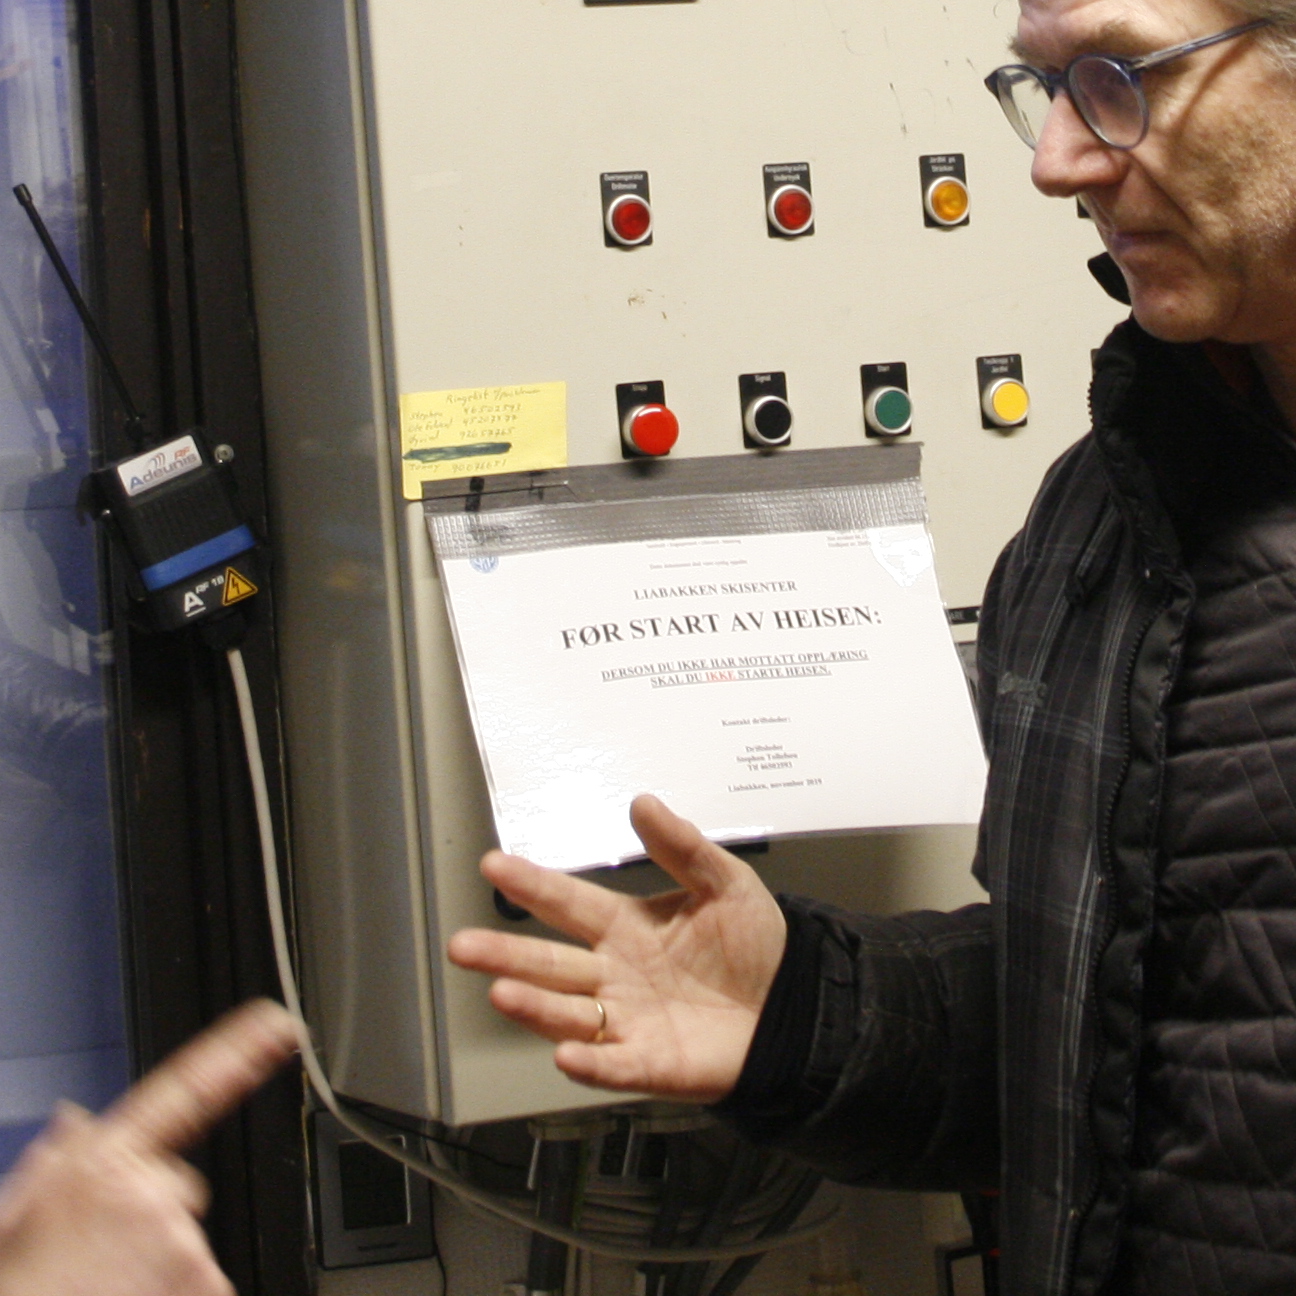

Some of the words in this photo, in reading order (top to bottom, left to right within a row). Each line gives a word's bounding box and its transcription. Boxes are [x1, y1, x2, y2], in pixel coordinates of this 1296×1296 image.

[173, 445, 193, 460] RF
[130, 454, 197, 490] Adeunis
[633, 584, 718, 600] LIABAKKEN
[720, 581, 798, 595] SKISENTER
[560, 622, 624, 650] FØR
[630, 613, 721, 639] START
[730, 611, 765, 632] AV
[772, 605, 882, 630] HEISEN:
[601, 663, 655, 680] DERSOM
[657, 660, 675, 673] DU
[677, 658, 708, 671] IKKE
[710, 656, 737, 669] HAR
[738, 653, 796, 667] MOTTATT
[798, 649, 869, 663] OPPLÆRING
[650, 675, 684, 688] SKAL
[686, 673, 704, 685] DU
[705, 670, 737, 682] IKKE
[737, 667, 784, 680] STARTE
[785, 664, 832, 677] HEISEN.
